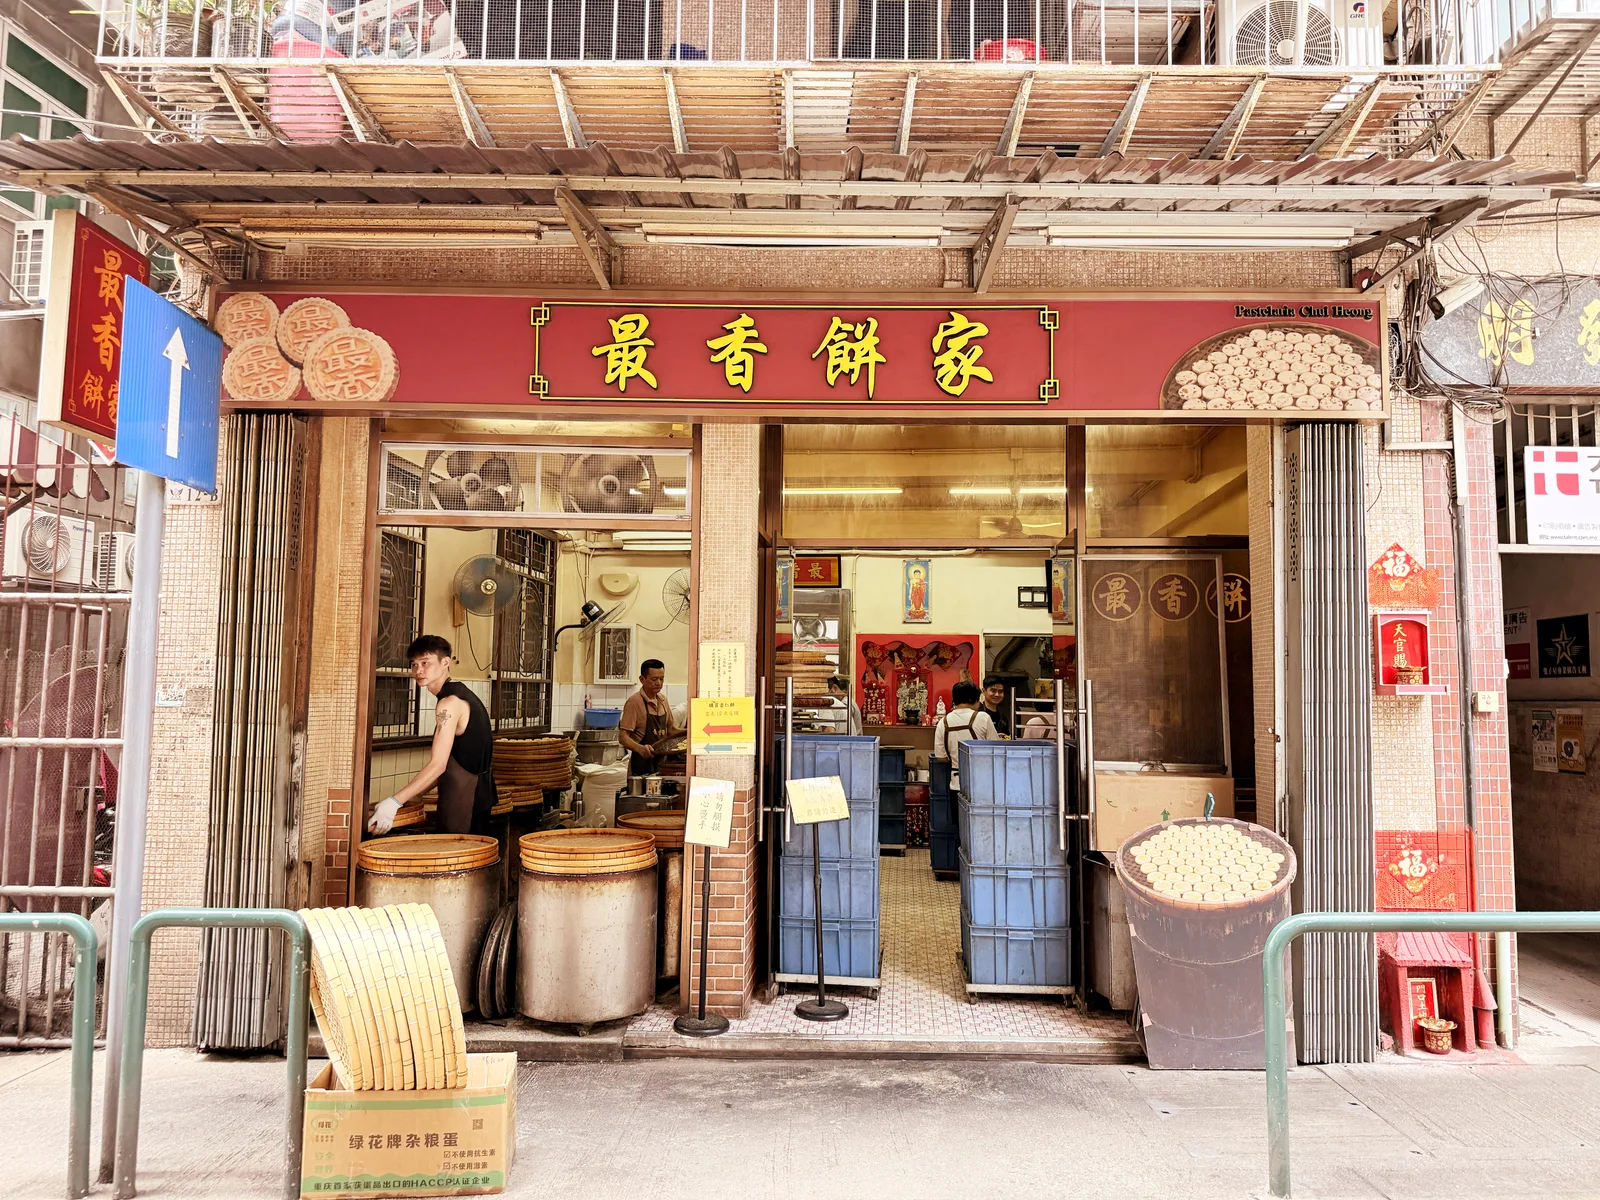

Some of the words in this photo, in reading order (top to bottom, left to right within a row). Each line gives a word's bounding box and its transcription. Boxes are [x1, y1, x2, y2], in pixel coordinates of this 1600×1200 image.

[92, 248, 124, 372] 最香
[1234, 305, 1295, 318] Pastelaria
[1299, 305, 1330, 318] Chui
[1332, 305, 1374, 321] Heong
[591, 312, 994, 399] 最香餅家
[1382, 551, 1410, 578] 福
[1392, 623, 1408, 669] 天官賜
[1398, 849, 1428, 877] 福
[348, 1132, 459, 1150] 绿花牌杂粮蛋
[451, 1149, 497, 1159] 不使用抗生素
[451, 1161, 489, 1171] 不使用激素
[313, 1176, 491, 1191] 重庆首家获蛋品出口的HACCP认证企业
